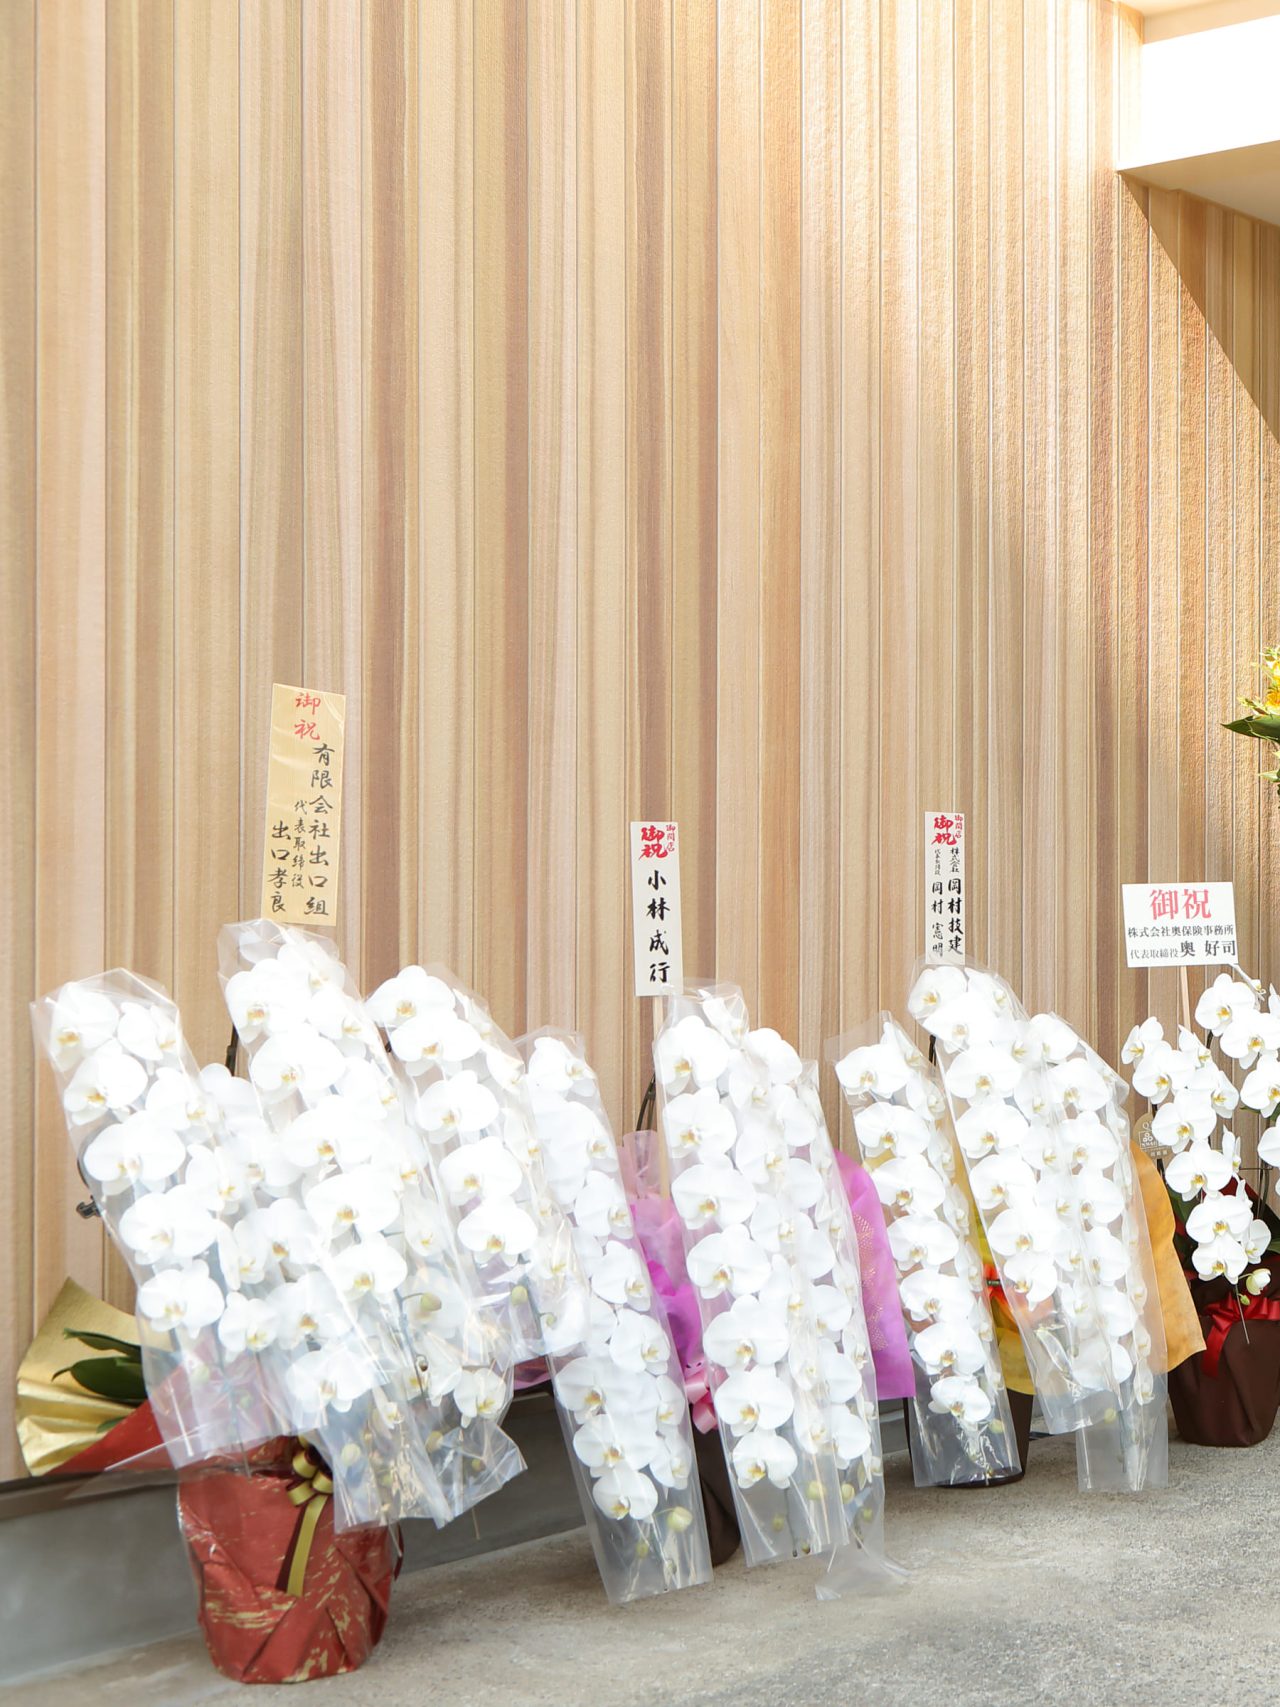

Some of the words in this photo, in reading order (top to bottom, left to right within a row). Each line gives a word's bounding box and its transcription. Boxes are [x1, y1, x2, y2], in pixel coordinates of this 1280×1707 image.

[294, 692, 321, 741] 御祝
[639, 825, 668, 861] 御祝
[931, 814, 957, 846] 御祝
[1149, 888, 1212, 921] 御祝
[646, 870, 671, 983] 小林成行
[1127, 924, 1234, 938] 株式会社奥保険事務所
